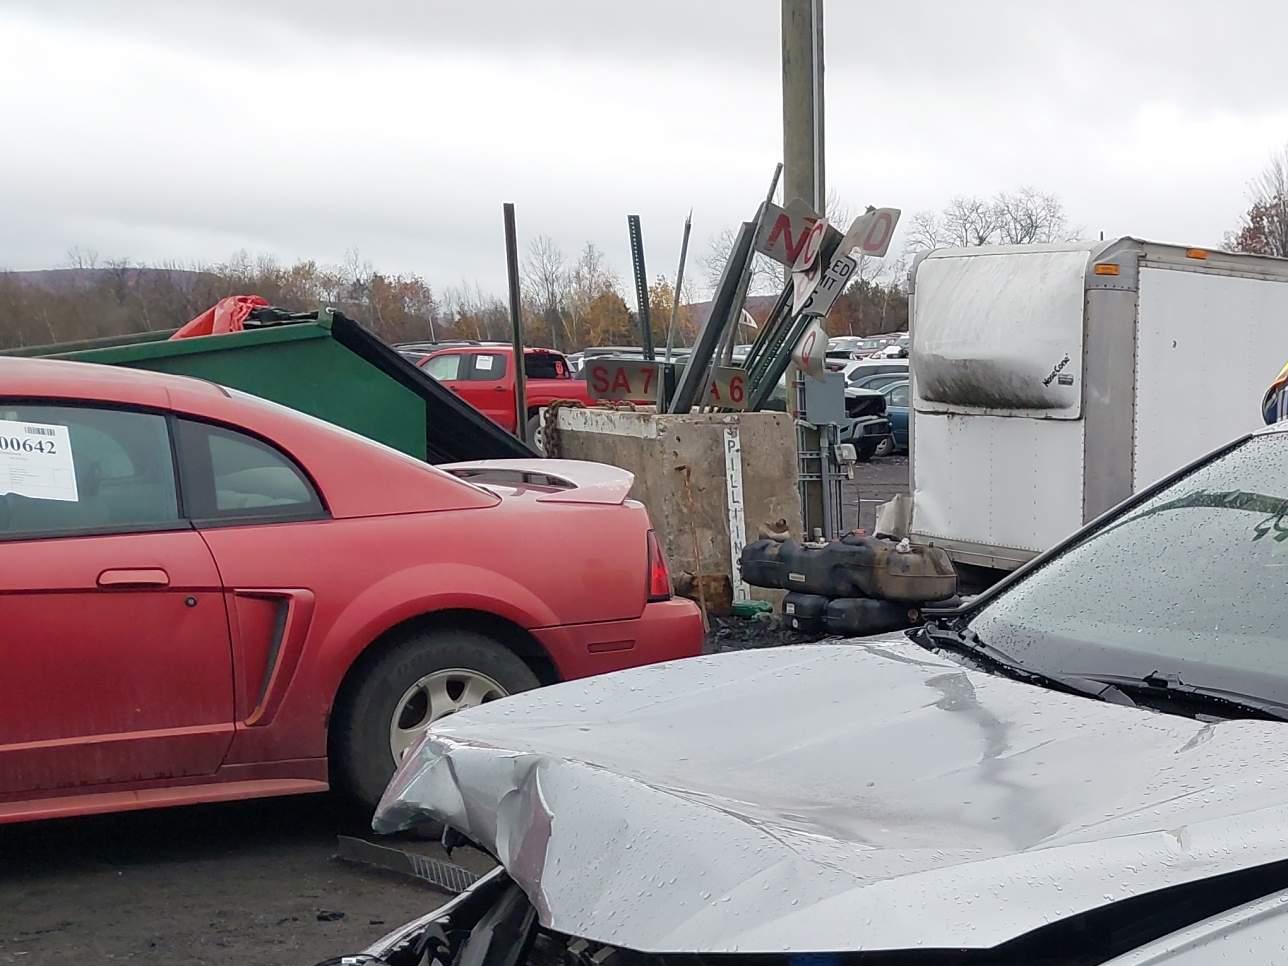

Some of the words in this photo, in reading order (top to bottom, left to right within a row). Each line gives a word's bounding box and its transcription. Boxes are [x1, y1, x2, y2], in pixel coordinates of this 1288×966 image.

[592, 367, 631, 394] SA
[640, 368, 655, 394] 7
[729, 375, 744, 403] 6
[0, 436, 57, 454] 00642
